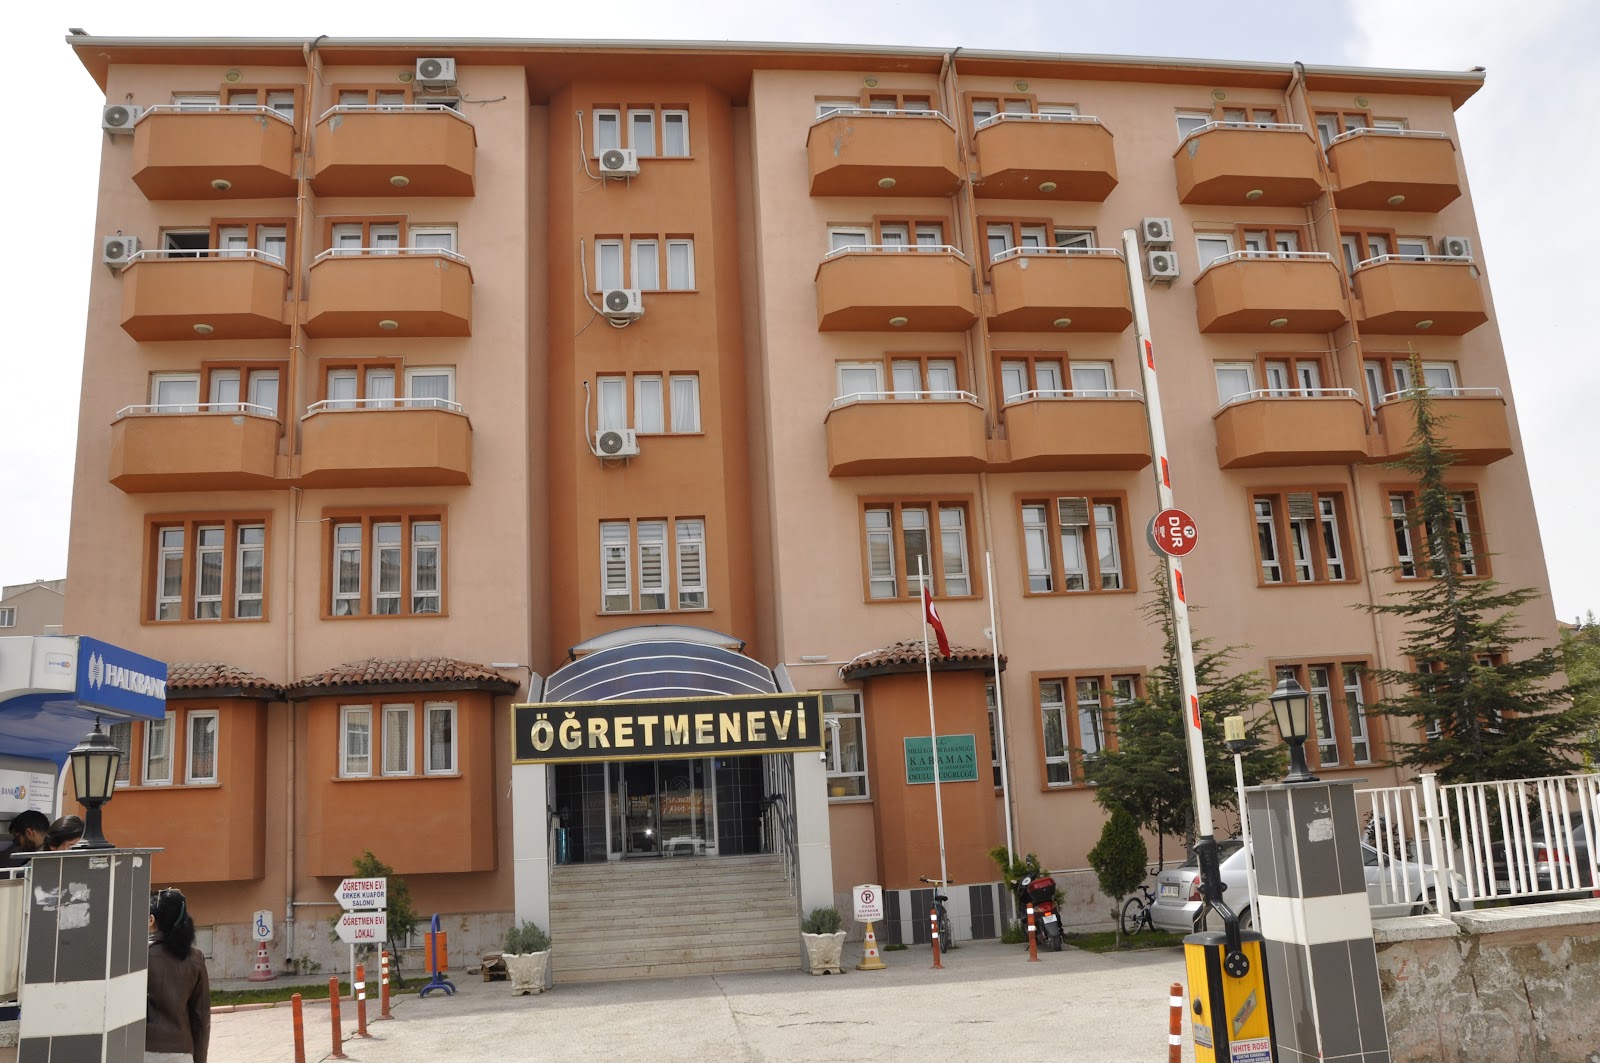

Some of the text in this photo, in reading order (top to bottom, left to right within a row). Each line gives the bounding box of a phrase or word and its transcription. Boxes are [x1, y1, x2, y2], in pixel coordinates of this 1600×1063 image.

[1168, 516, 1183, 548] DUR
[105, 663, 166, 700] HALKBANK
[530, 701, 807, 751] ÖĞRETMENEVİ
[910, 754, 974, 766] KARAMAN
[908, 772, 931, 781] OKULU
[342, 880, 374, 891] ÖĞRETMEN
[342, 916, 374, 926] ÖĞRETMEN
[1232, 1041, 1268, 1053] WHITE ROSE
